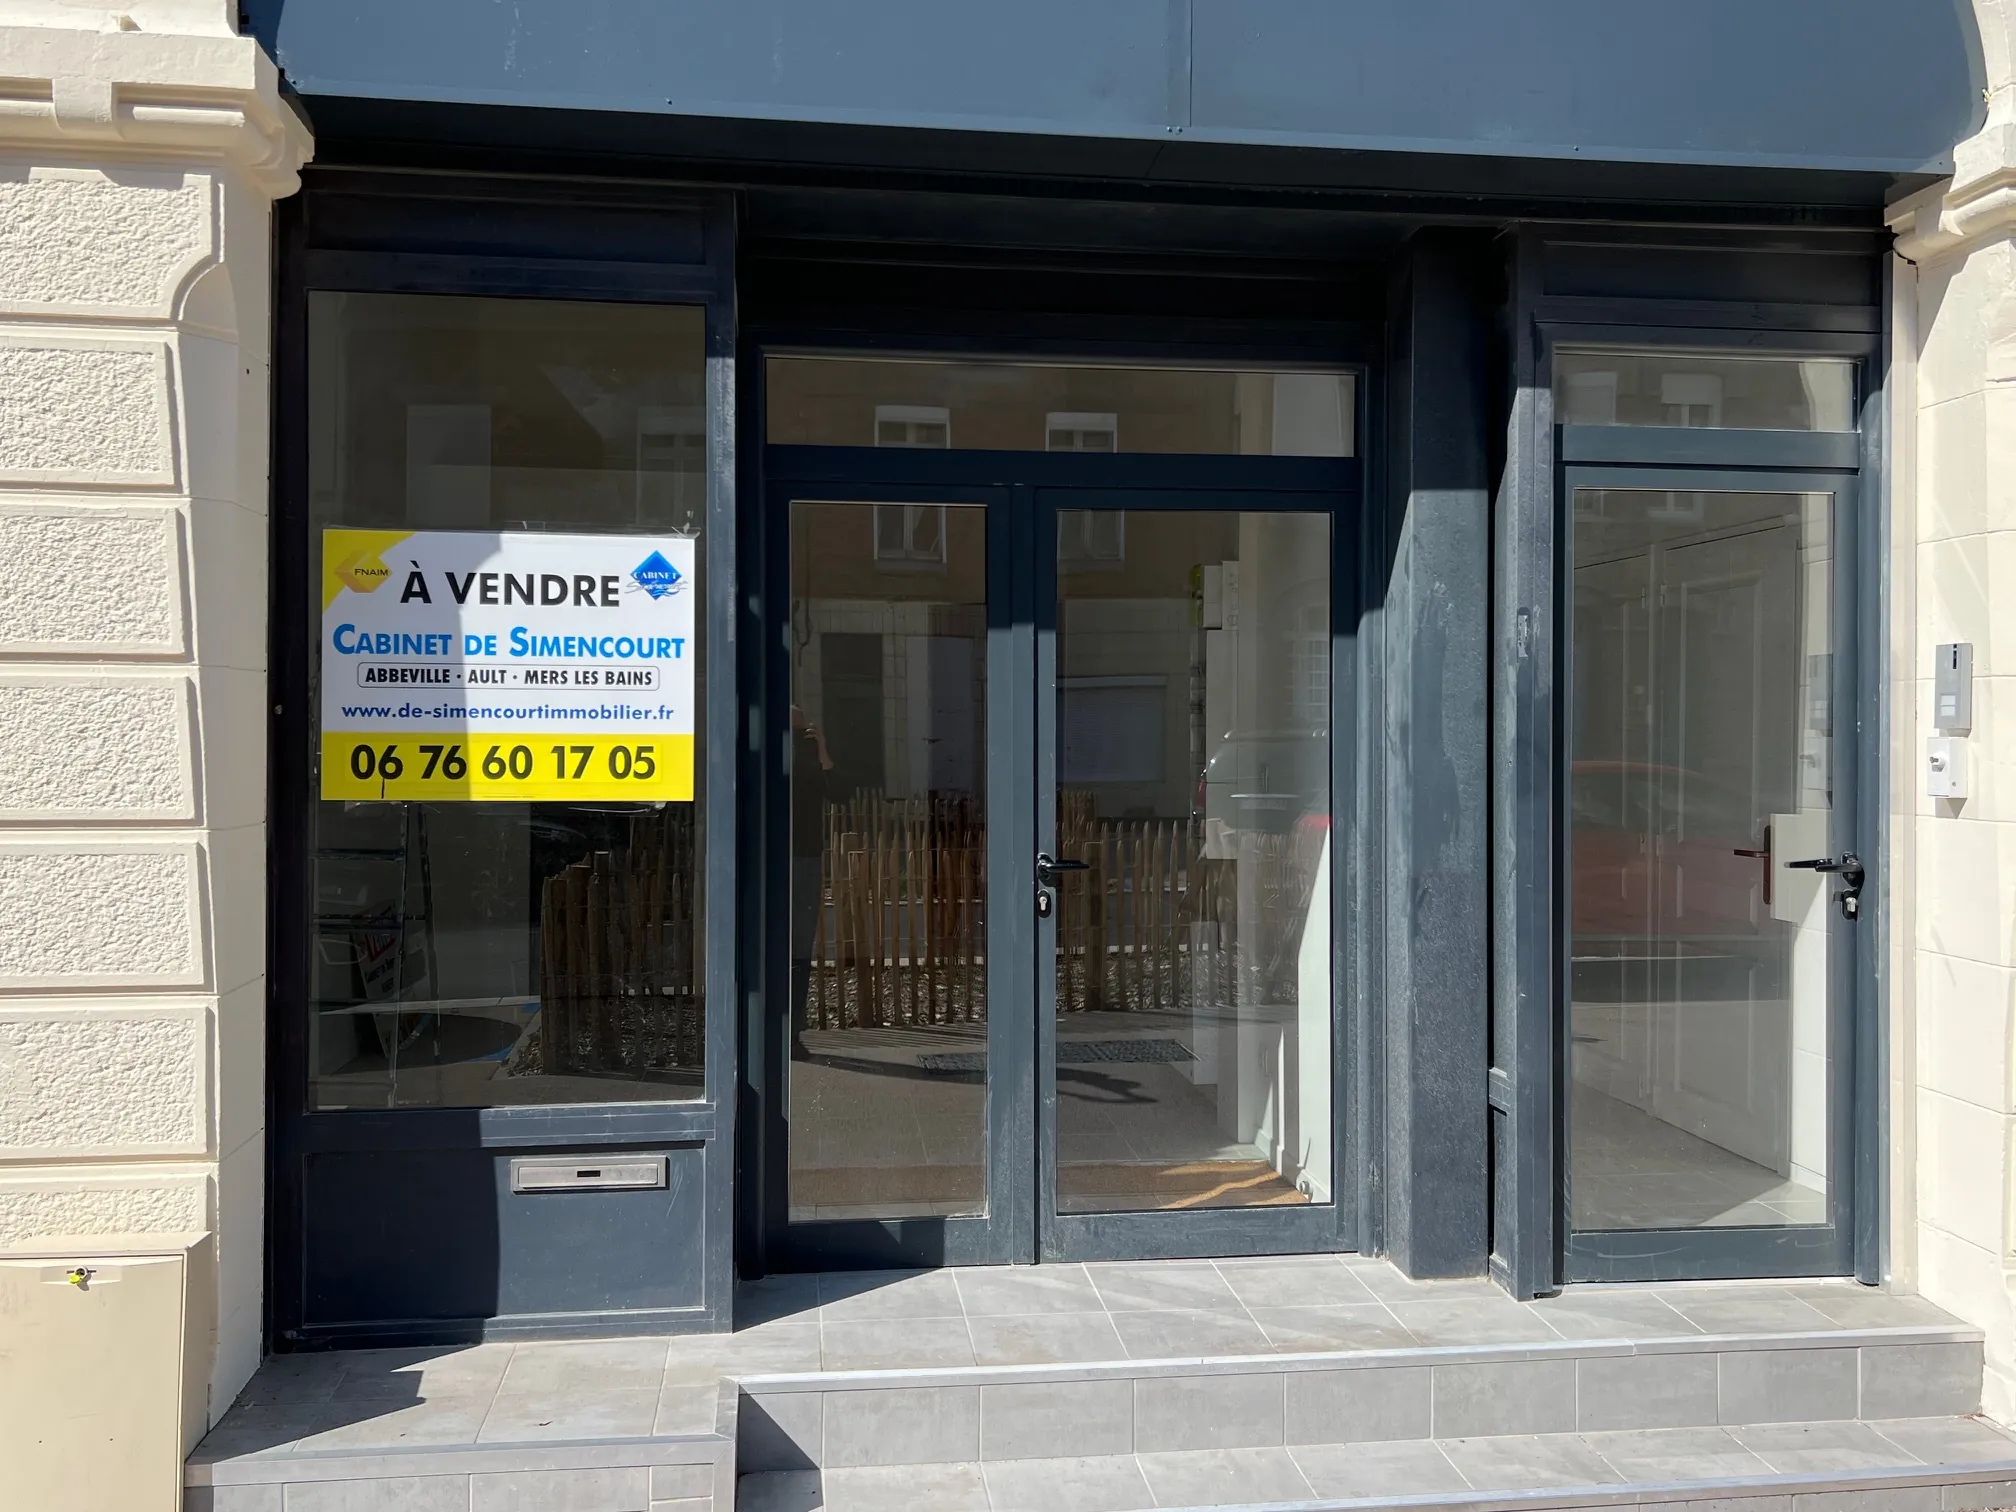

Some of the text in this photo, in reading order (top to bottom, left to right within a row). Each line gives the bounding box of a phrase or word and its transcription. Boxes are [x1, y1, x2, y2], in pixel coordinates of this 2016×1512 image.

[354, 568, 389, 577] FNAIM
[633, 571, 678, 580] CABINET
[400, 560, 432, 604] À
[446, 572, 620, 608] VENDRE
[333, 623, 685, 659] CABINET DE SIMENCOURT
[365, 668, 653, 686] ABBEVILLE AULT MERS LES BAINS
[342, 702, 674, 721] www.de-simencourtimmobilier.fr
[350, 744, 656, 780] 06 76 60 17 05
